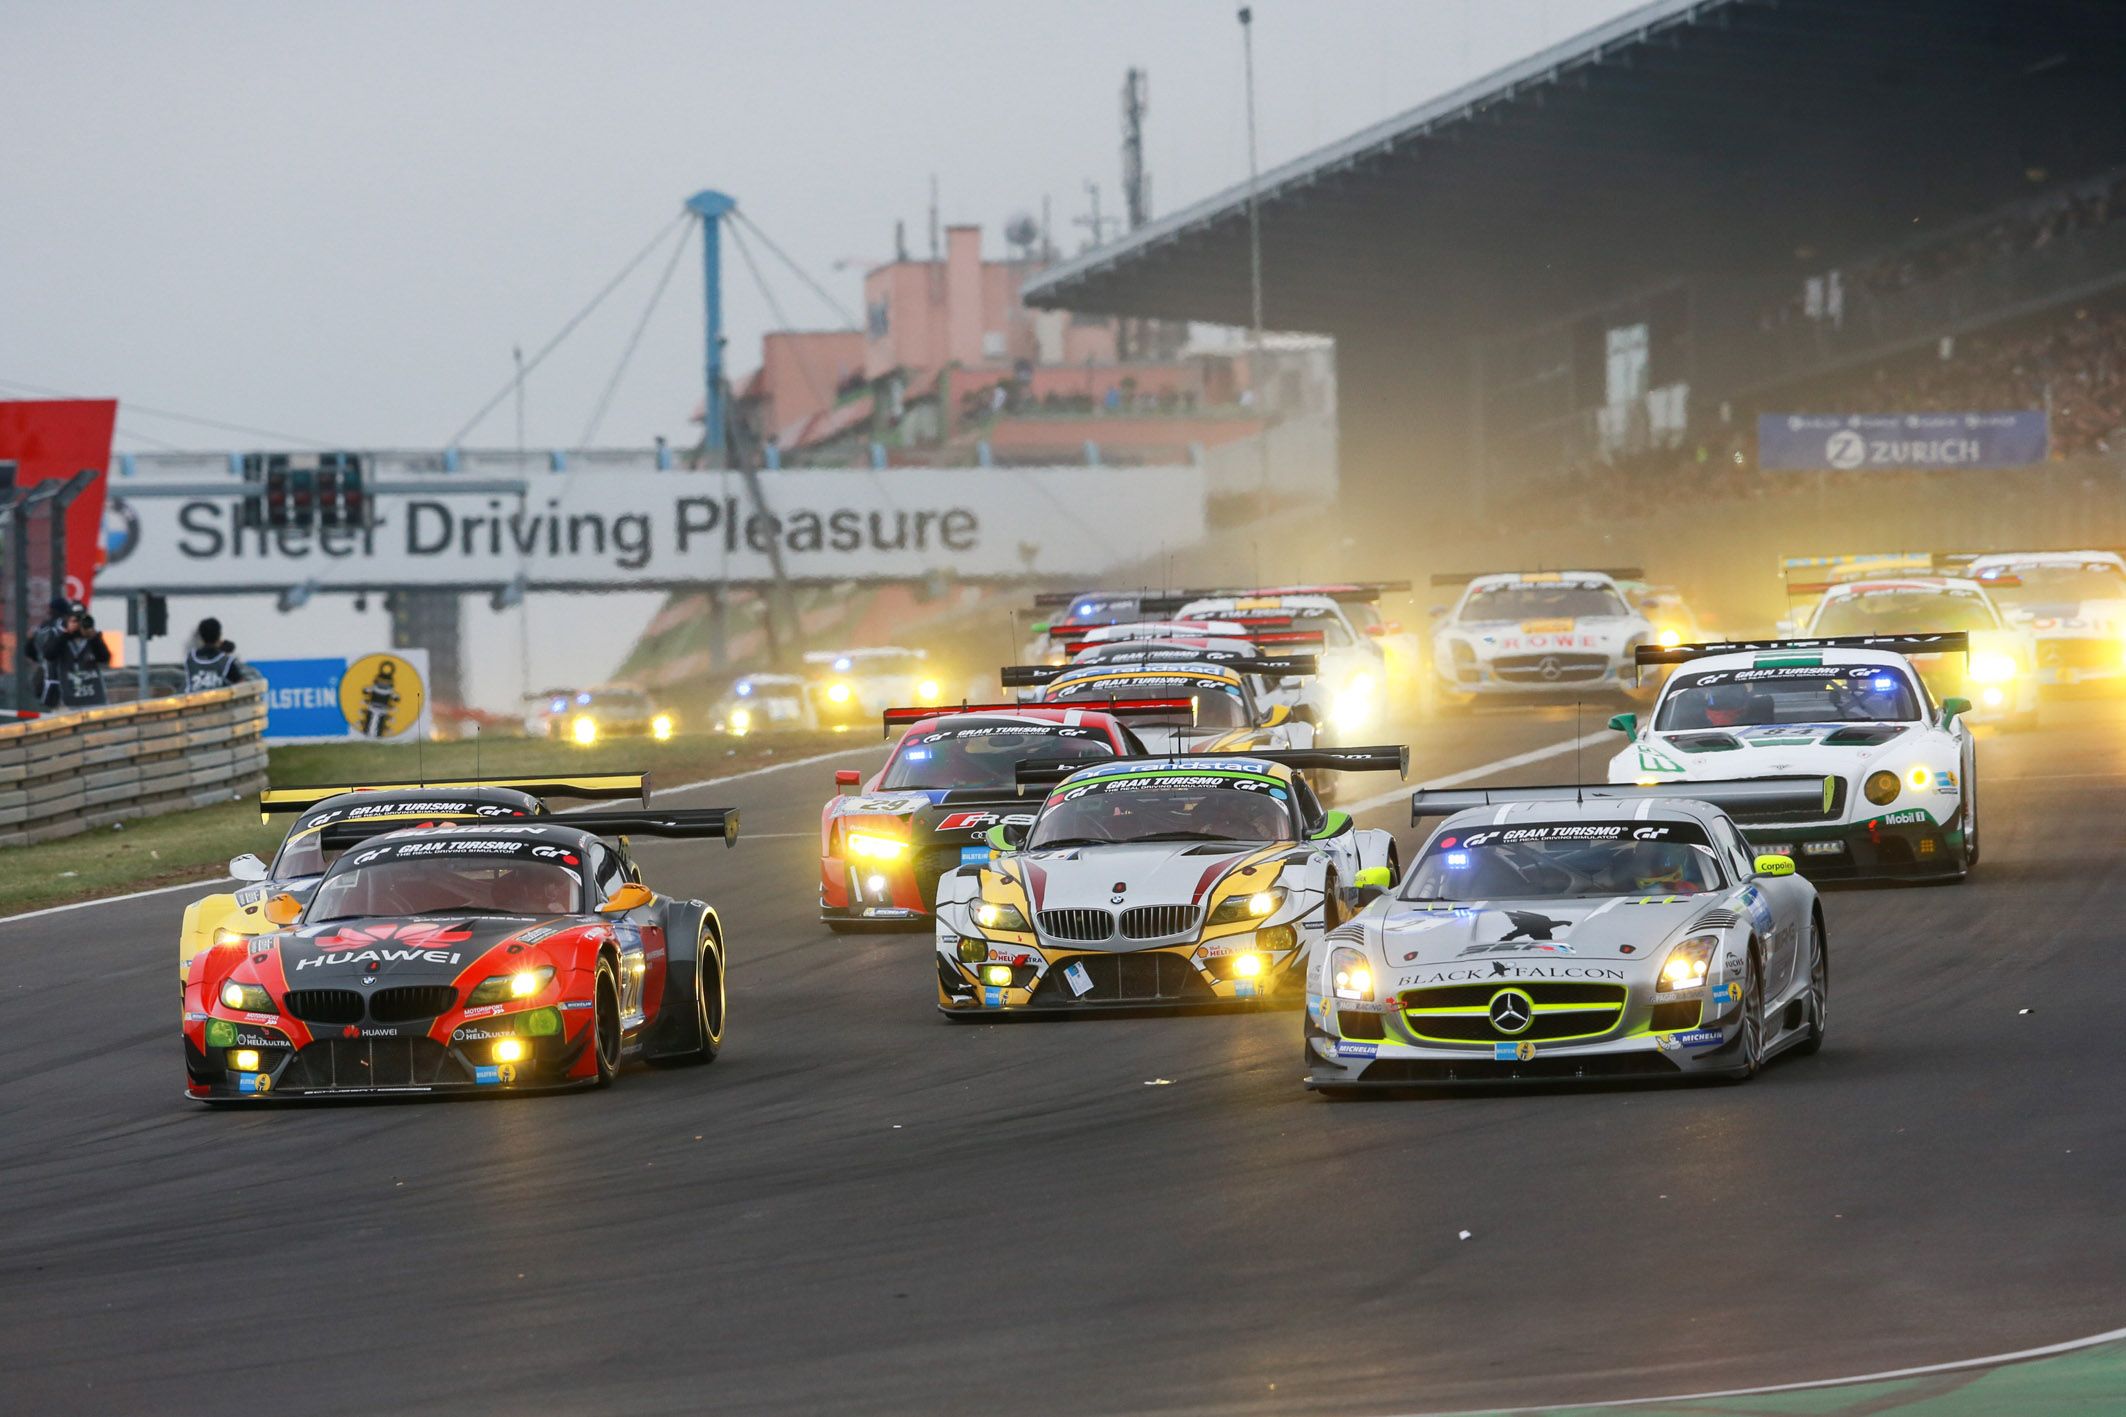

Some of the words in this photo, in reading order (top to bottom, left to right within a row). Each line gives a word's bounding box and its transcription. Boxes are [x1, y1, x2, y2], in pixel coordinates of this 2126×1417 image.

[1871, 440, 1980, 463] ZURICH
[178, 502, 386, 558] Sheer
[407, 501, 652, 569] Driving
[675, 496, 978, 553] Pleasure
[1503, 634, 1596, 649] ROWE
[1112, 665, 1221, 675] randstad
[1734, 669, 1775, 679] GRAN
[1778, 667, 1840, 675] TURISMO
[1092, 678, 1130, 688] GRAN
[1132, 677, 1188, 685] TURISMO
[264, 687, 338, 710] ILSTEIN
[957, 727, 993, 737] GRAN
[996, 726, 1051, 734] TURISMO
[1130, 762, 1263, 774] randstad
[1106, 778, 1152, 790] GRAN
[1154, 776, 1224, 786] TURISMO
[349, 804, 396, 816] GRAN
[397, 802, 467, 811] TURISMO
[860, 800, 909, 811] 29
[1885, 812, 1915, 825] Mobil
[1503, 828, 1550, 840] GRAN
[1551, 826, 1621, 836] TURISMO
[398, 841, 447, 854] GRAN
[448, 840, 523, 851] TURISMO
[962, 852, 989, 861] BILSTEIN
[296, 949, 462, 971] HUAWEI
[1725, 958, 1744, 968] FUCHS
[1398, 968, 1484, 986] BLACK
[1514, 967, 1625, 980] FALCON
[1655, 993, 1676, 1003] PAGID
[464, 1004, 503, 1015] MOTORSPORT
[246, 1012, 280, 1021] MOTORSPORT
[361, 1028, 398, 1037] HUAWEI
[466, 1030, 491, 1040] HELIX
[1682, 1031, 1723, 1043] MICHELIN
[246, 1038, 268, 1046] HELIX
[1339, 1044, 1378, 1054] MICHELIN
